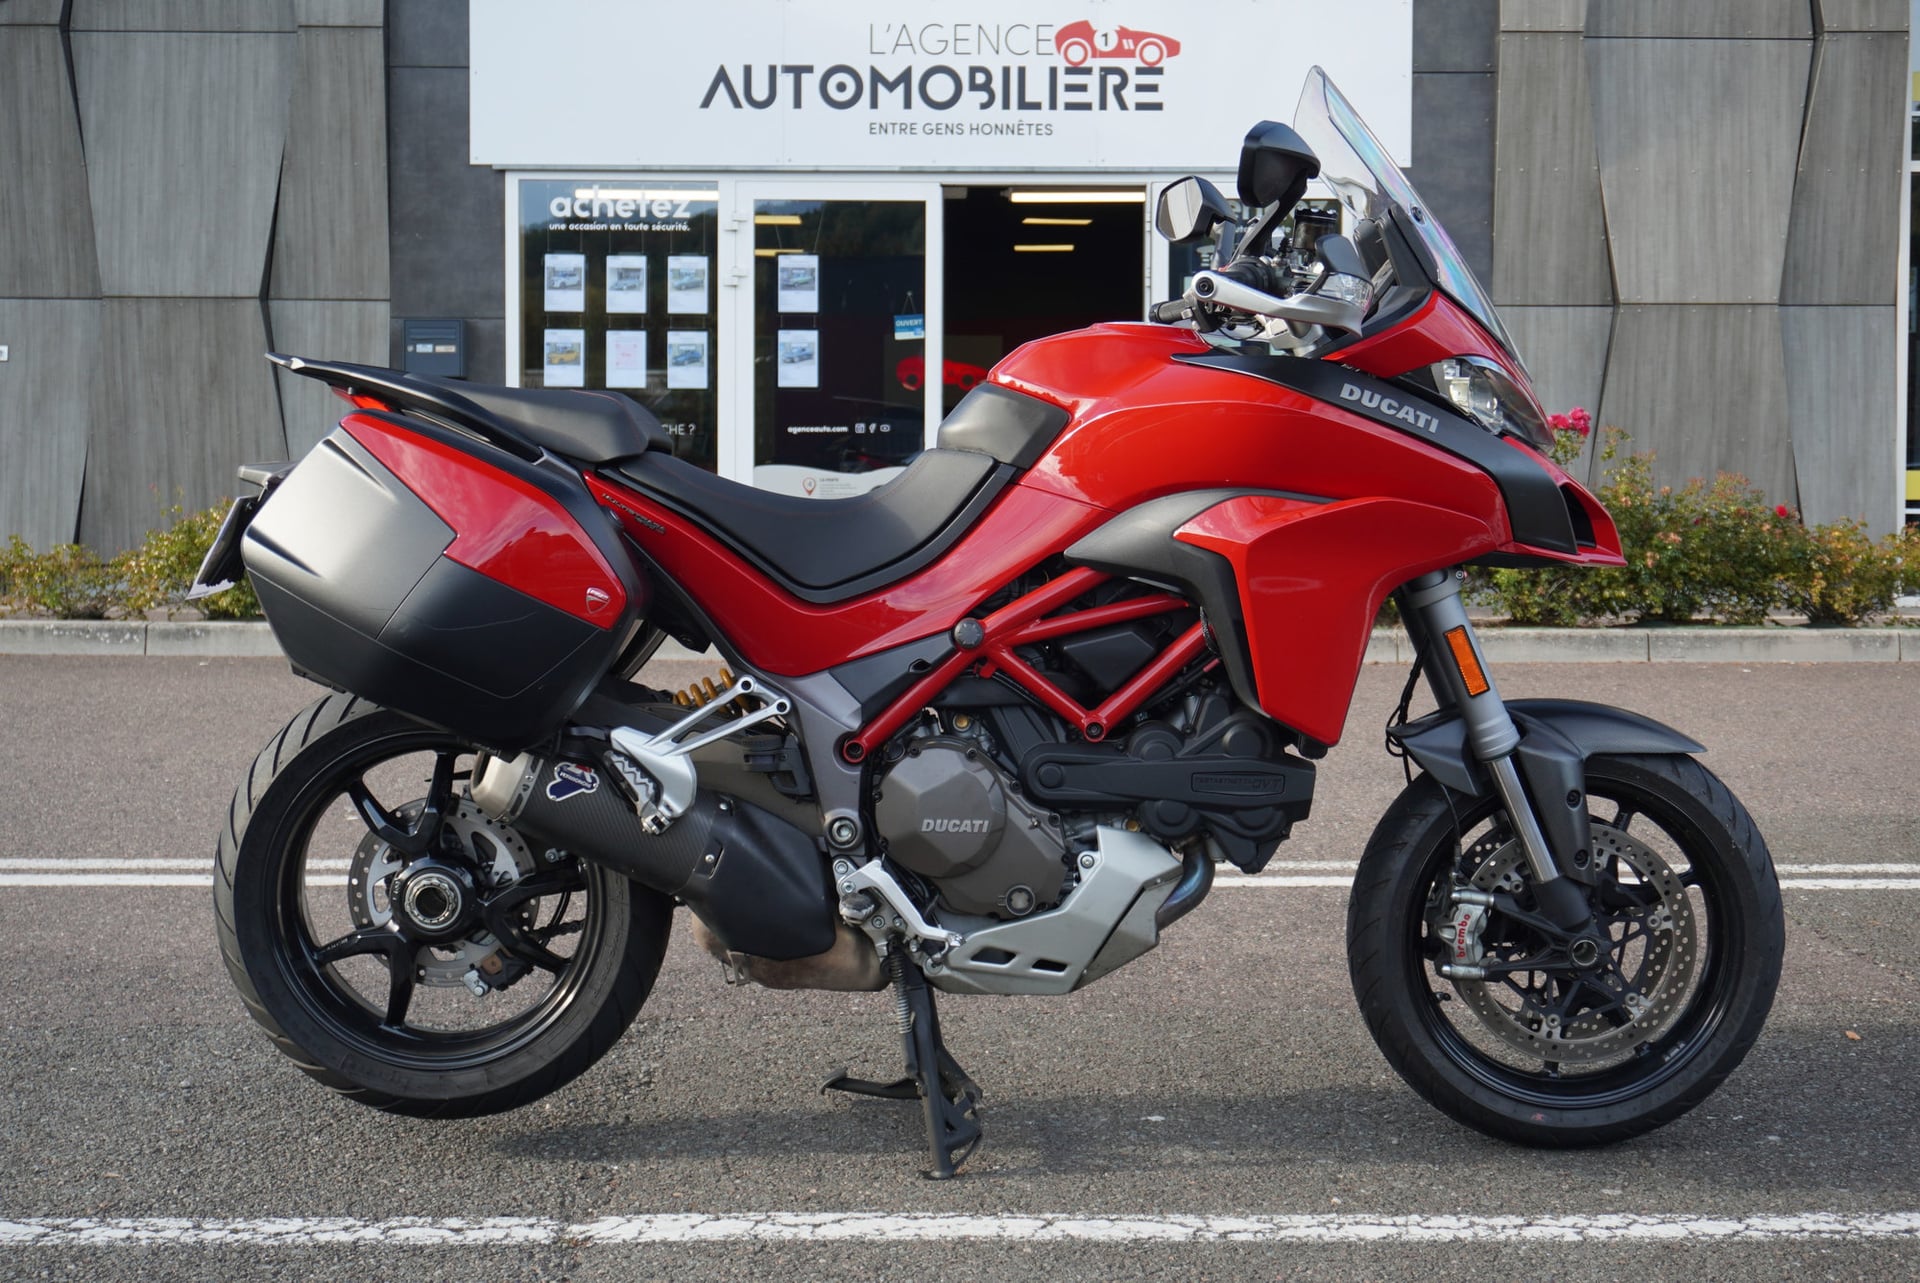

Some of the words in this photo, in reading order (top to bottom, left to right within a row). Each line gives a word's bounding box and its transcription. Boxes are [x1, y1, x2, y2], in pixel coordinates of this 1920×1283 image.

[870, 24, 1053, 55] L'AGENCE
[1101, 32, 1109, 47] 1
[869, 122, 917, 135] ENTRE
[922, 122, 964, 136] GENS
[969, 120, 1053, 136] HONNÊTES
[550, 185, 691, 218] achetez
[549, 223, 566, 231] une
[568, 221, 607, 231] occasion
[610, 223, 621, 231] en
[624, 221, 649, 231] toute
[1339, 382, 1440, 434] DUCATI
[921, 819, 989, 833] DUCATI
[1456, 914, 1471, 958] brembo
